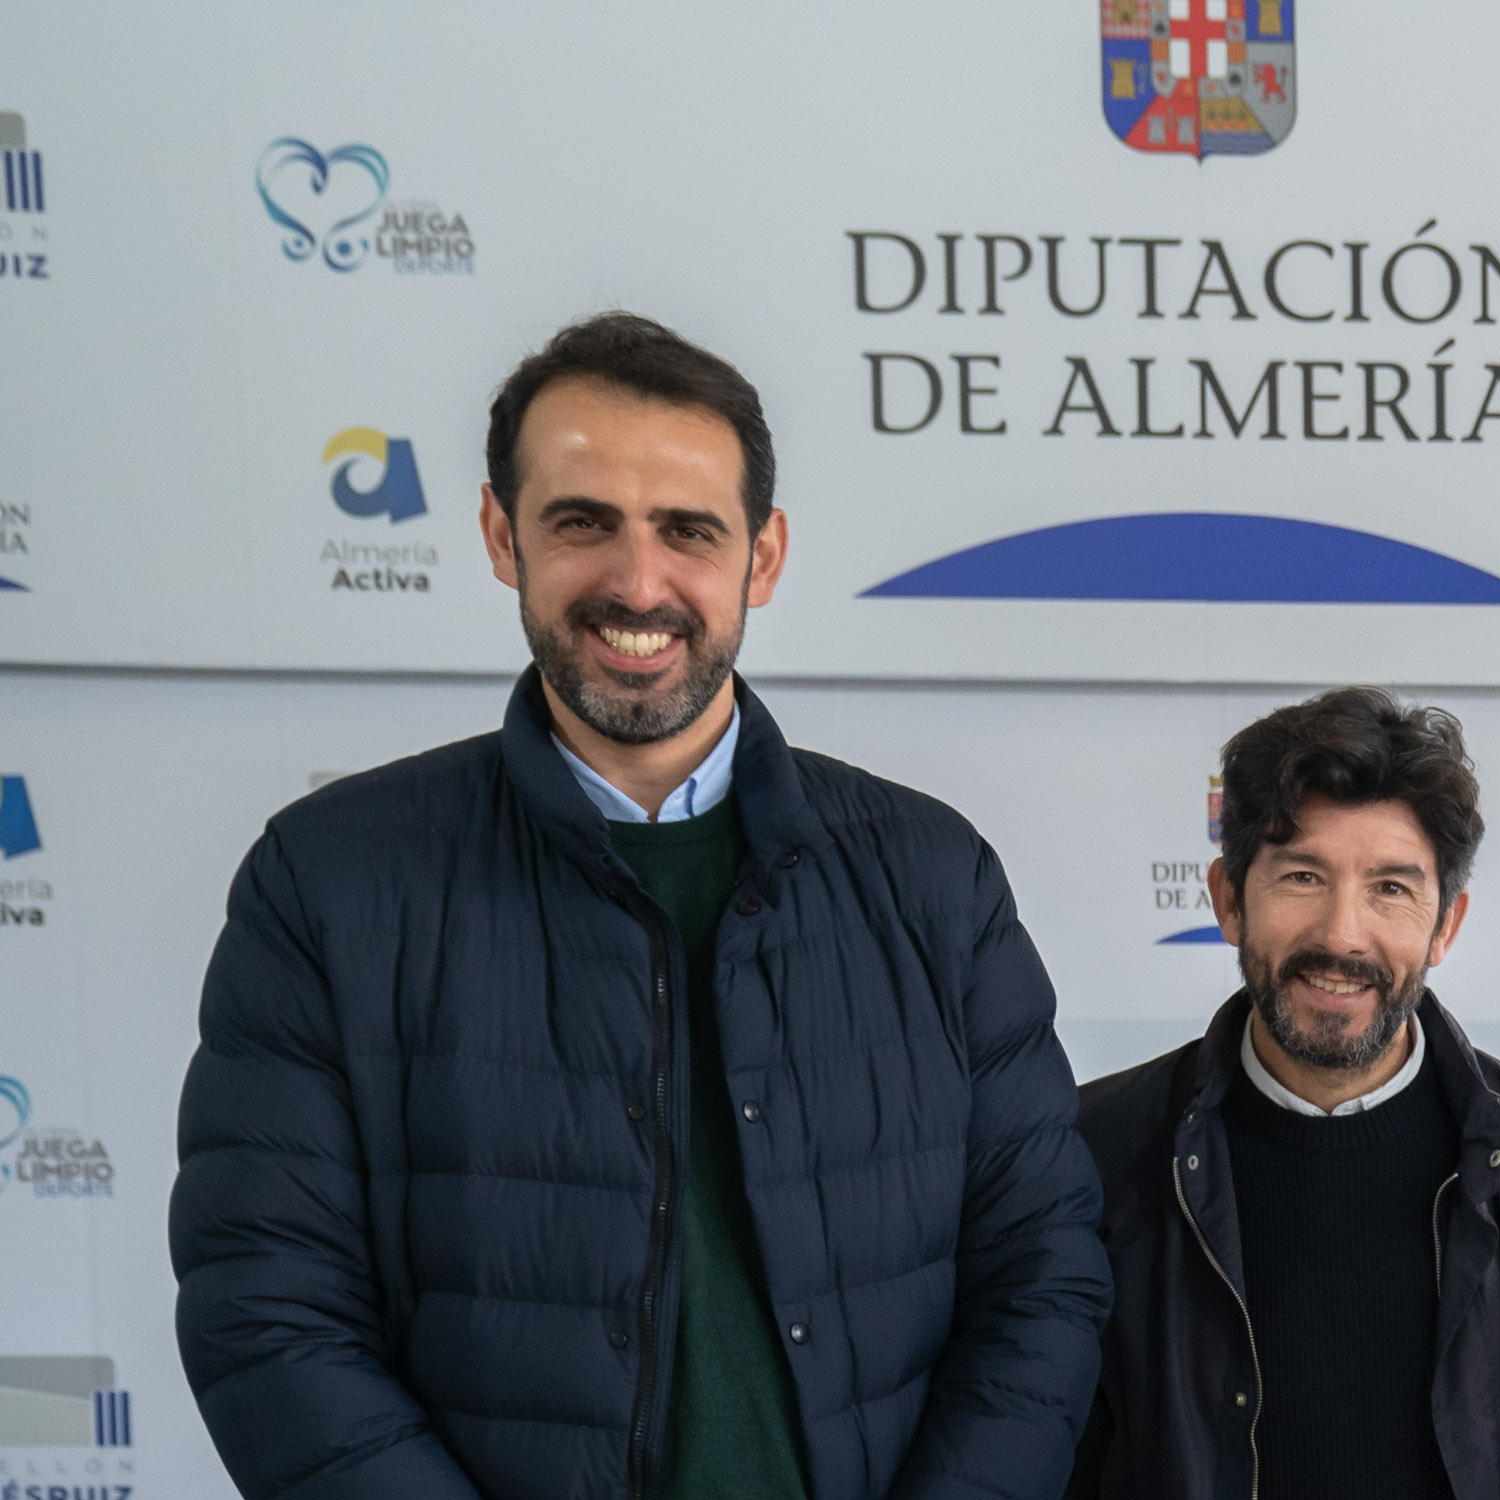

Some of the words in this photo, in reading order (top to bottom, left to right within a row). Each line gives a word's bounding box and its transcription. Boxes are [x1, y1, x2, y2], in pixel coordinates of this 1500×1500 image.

[377, 212, 468, 236] JUEGA
[375, 234, 475, 260] LIMPIO
[862, 352, 1007, 436] DE
[320, 539, 438, 567] Almería
[330, 566, 431, 592] Activa
[1155, 888, 1187, 910] DE
[19, 1138, 108, 1162] JUEGA
[16, 1160, 114, 1183] LIMPIO
